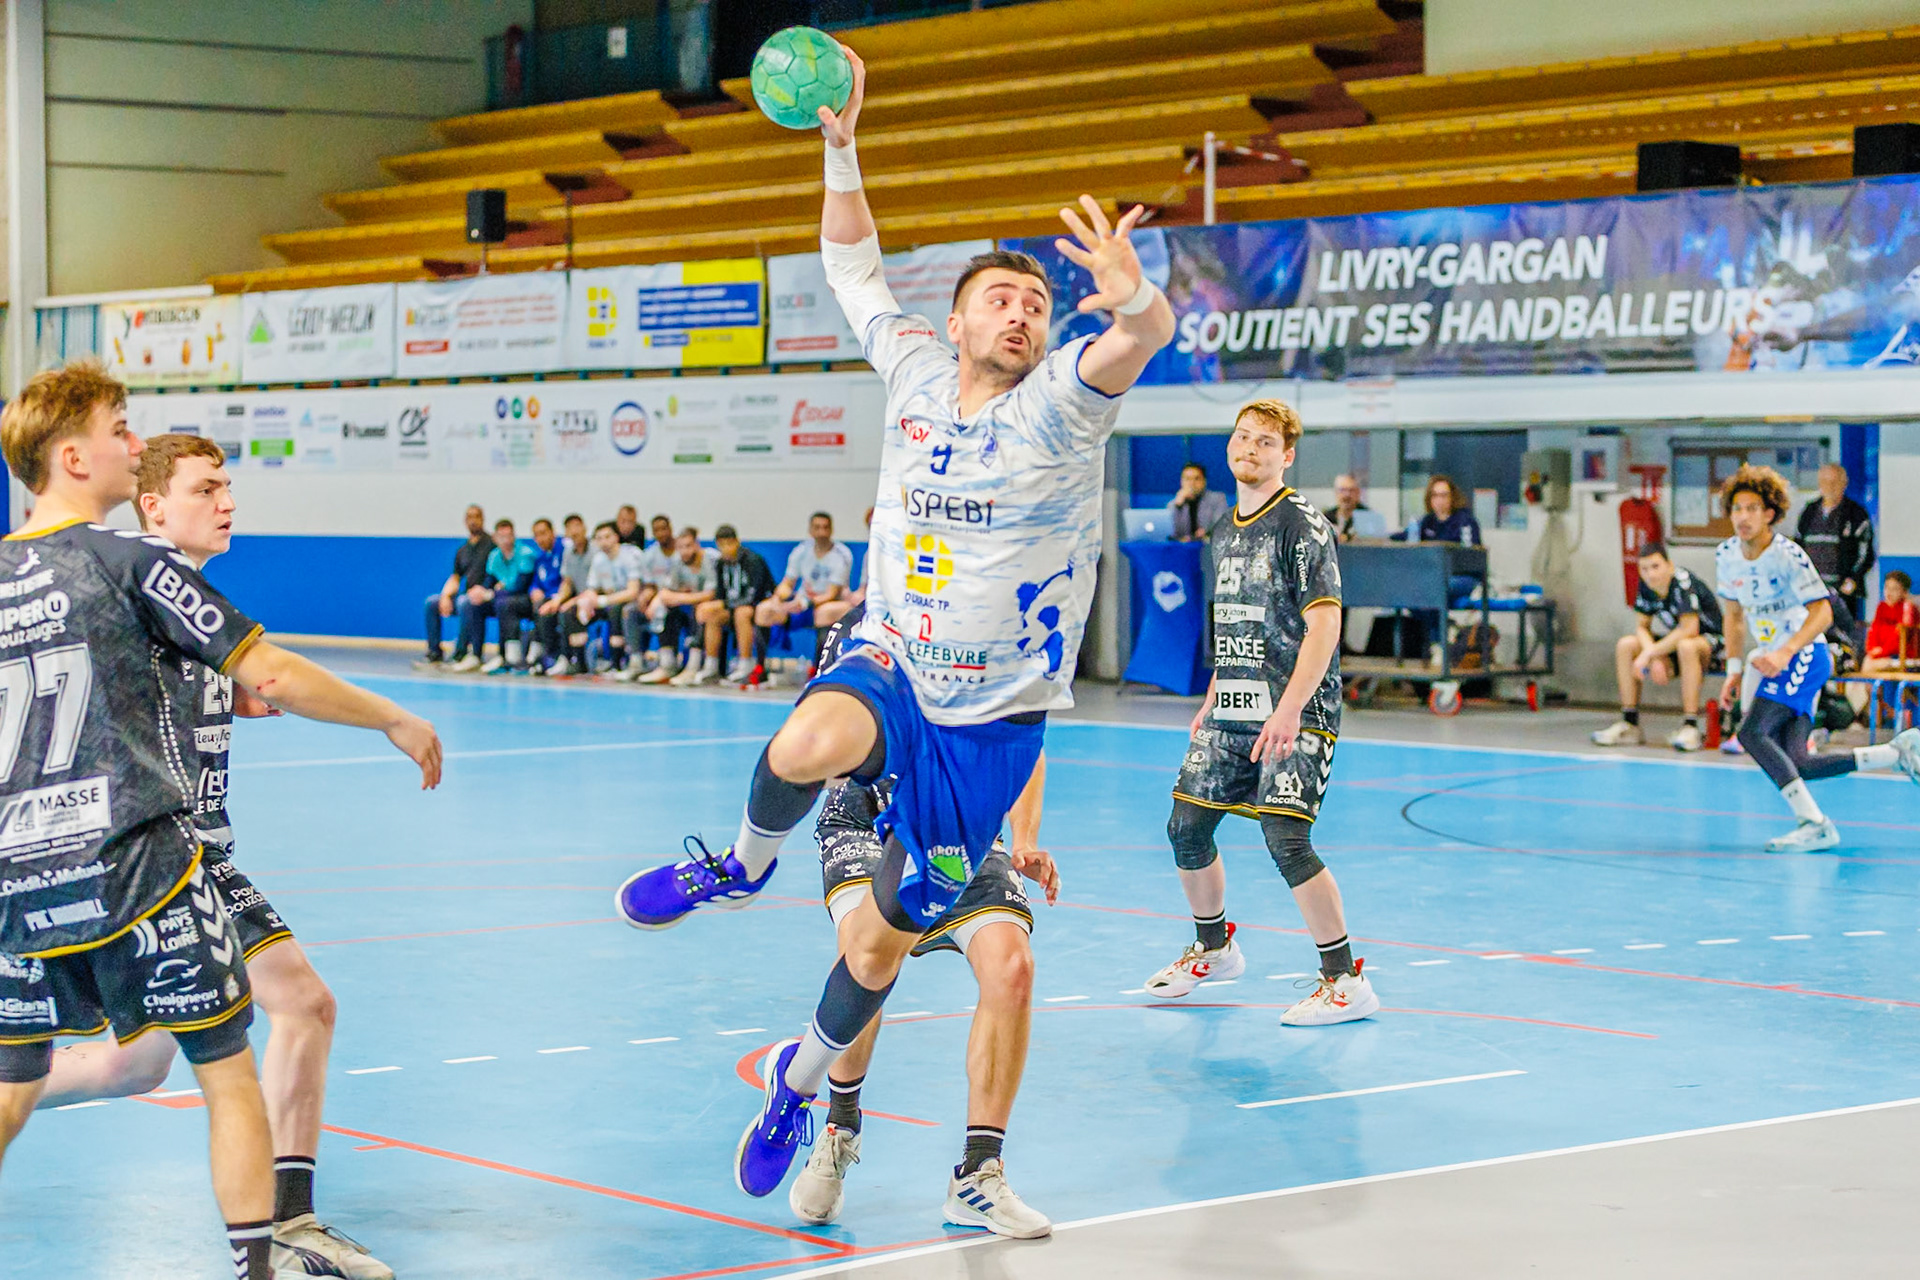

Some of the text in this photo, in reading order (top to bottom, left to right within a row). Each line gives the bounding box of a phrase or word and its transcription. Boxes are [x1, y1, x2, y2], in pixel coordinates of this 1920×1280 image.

[1318, 235, 1608, 293] LIVRY-GARGAN
[1177, 287, 1776, 354] SOUTIENT SES HANDBALLEURS
[1215, 557, 1246, 595] 25
[157, 566, 226, 634] BDO
[938, 599, 950, 611] TP
[0, 619, 66, 649] ouzauges
[1215, 634, 1266, 659] ENDÉE
[907, 641, 988, 665] LEFEBVRE
[158, 912, 194, 934] PAYS
[160, 930, 201, 953] LOIRE
